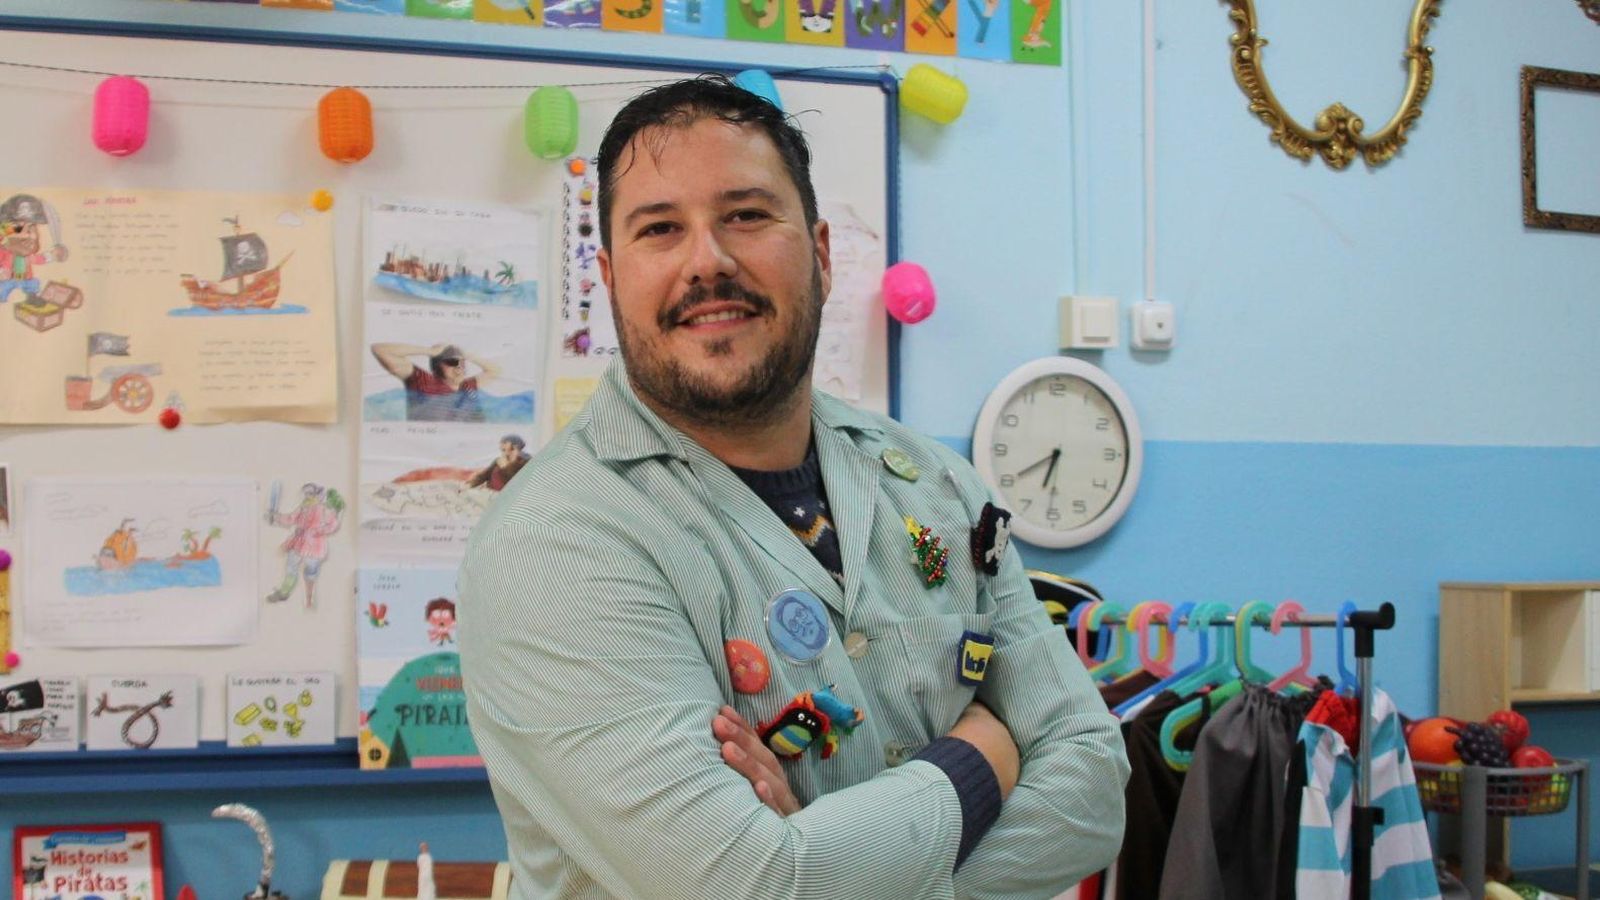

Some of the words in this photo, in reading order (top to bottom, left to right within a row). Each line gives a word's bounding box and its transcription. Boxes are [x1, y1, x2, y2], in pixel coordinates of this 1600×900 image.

[1048, 382, 1067, 397] 12
[1096, 417, 1110, 431] 2
[994, 443, 1008, 456] 9
[1103, 447, 1116, 462] 3
[1000, 473, 1015, 488] 8
[1092, 477, 1108, 491] 4
[1019, 498, 1033, 512] 7
[1071, 499, 1088, 514] 5
[1045, 507, 1061, 521] 6
[51, 850, 129, 866] Historias
[78, 865, 93, 878] de
[54, 875, 128, 893] Piratas
